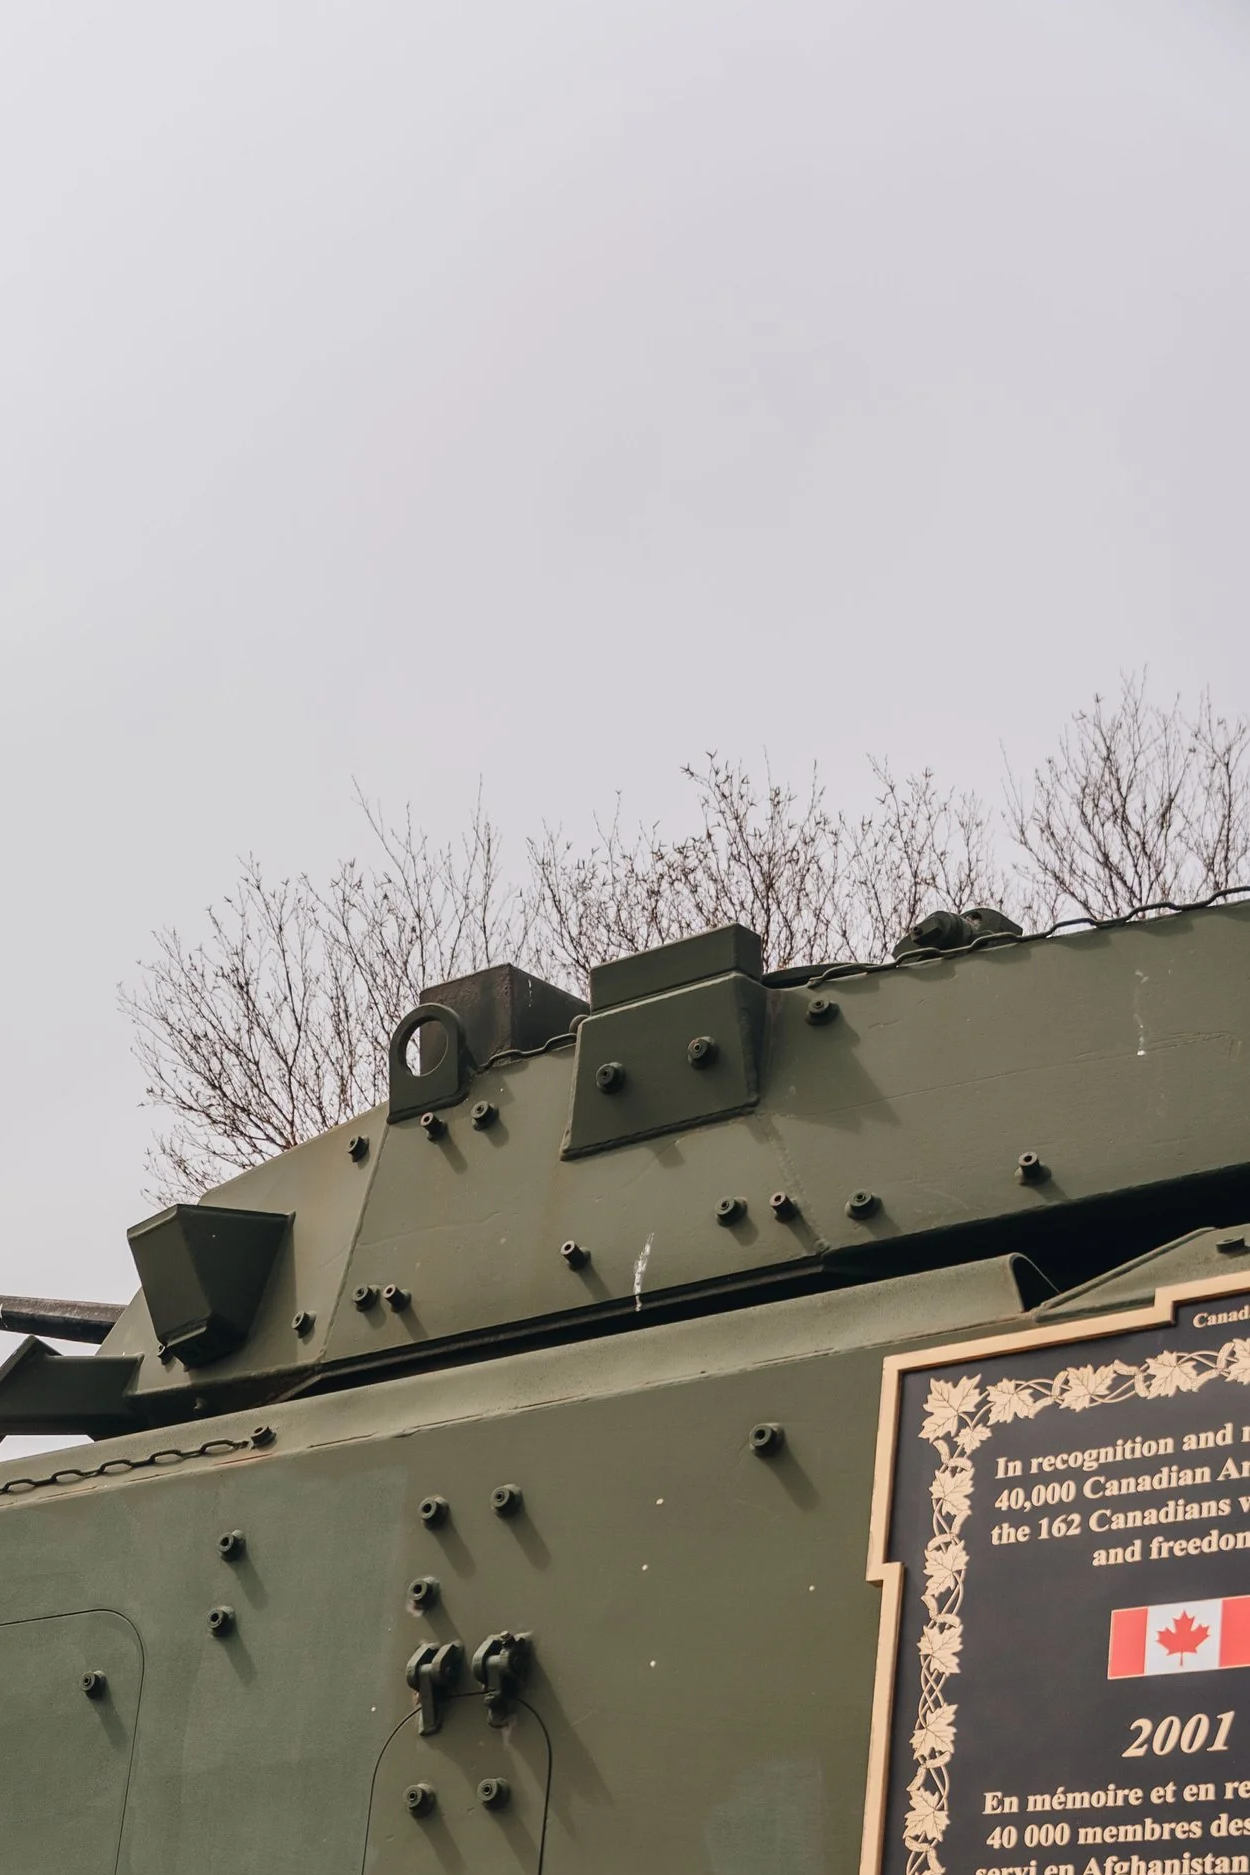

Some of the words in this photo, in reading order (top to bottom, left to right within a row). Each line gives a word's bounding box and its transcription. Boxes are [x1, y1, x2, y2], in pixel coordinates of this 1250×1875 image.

[994, 1456, 1022, 1480] In
[1029, 1436, 1175, 1471] recognition
[1181, 1423, 1234, 1452] and
[994, 1480, 1077, 1513] 40,000
[1083, 1464, 1211, 1499] Canadian
[990, 1522, 1031, 1546] the
[1037, 1512, 1082, 1540] 162
[1088, 1496, 1231, 1533] Canadians
[1092, 1538, 1143, 1567] and
[1121, 1710, 1235, 1758] 2001
[981, 1791, 1019, 1816] En
[1026, 1783, 1144, 1812] mémoire
[1149, 1781, 1177, 1805] et
[1182, 1783, 1216, 1802] en
[986, 1825, 1018, 1850] 40
[1024, 1822, 1071, 1848] 000
[1077, 1817, 1203, 1845] membres
